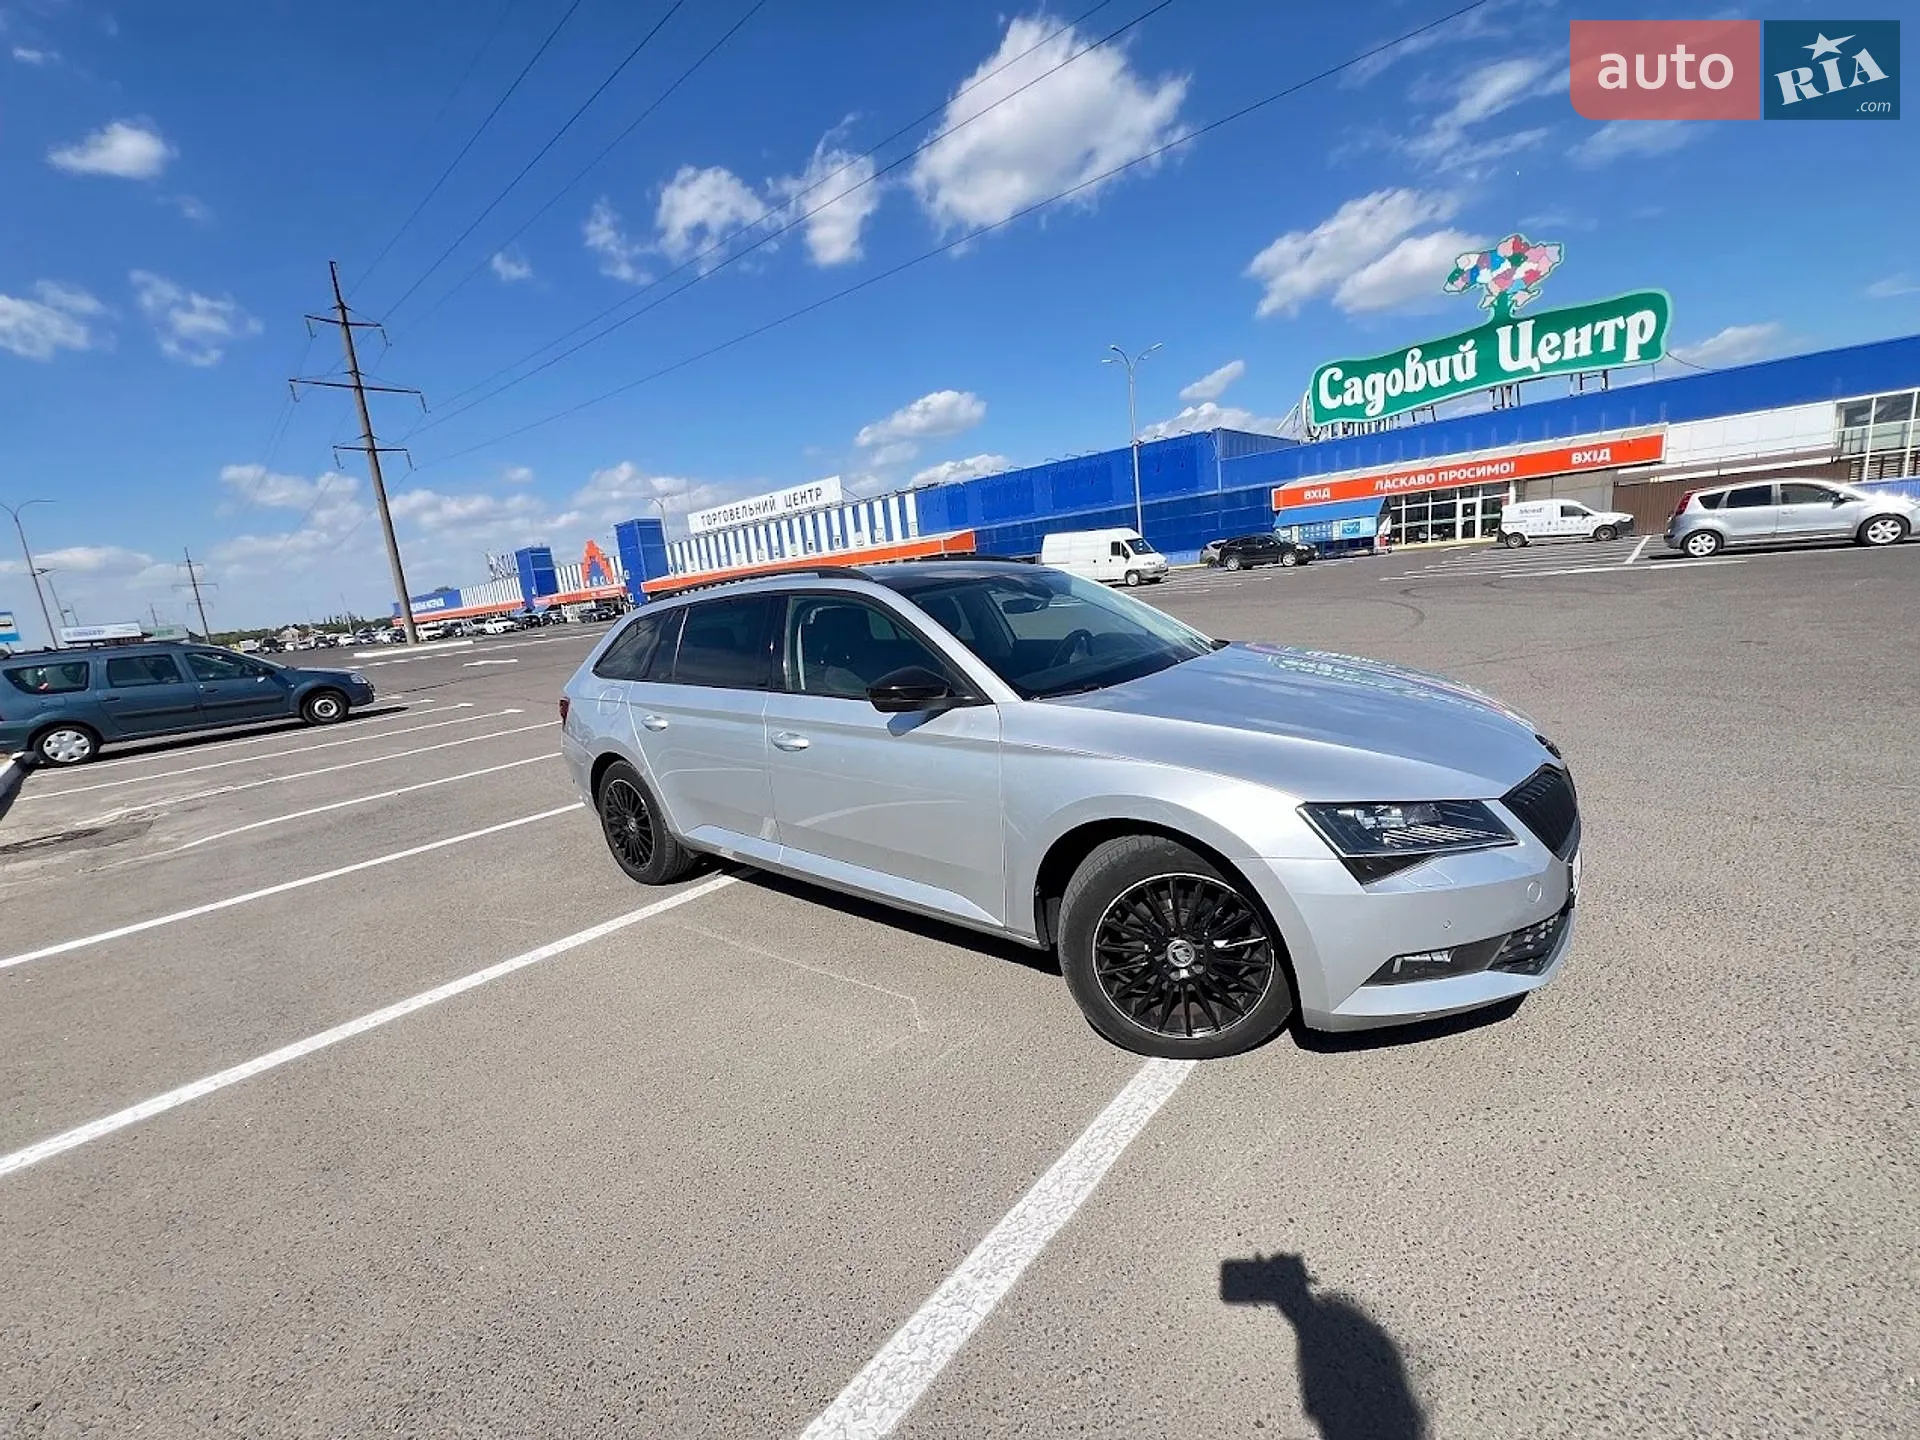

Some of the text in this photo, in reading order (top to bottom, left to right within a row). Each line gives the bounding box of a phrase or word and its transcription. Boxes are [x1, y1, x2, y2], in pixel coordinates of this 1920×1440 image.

[1318, 309, 1657, 416] Садовий Центр
[1571, 448, 1611, 464] ВХІД
[1374, 461, 1515, 491] ЛАСКАВО ПРОСИМО!
[701, 487, 823, 526] ТОРГОВЕЛЬНИЙ ЦЕНТР
[1303, 487, 1331, 500] ВХІД
